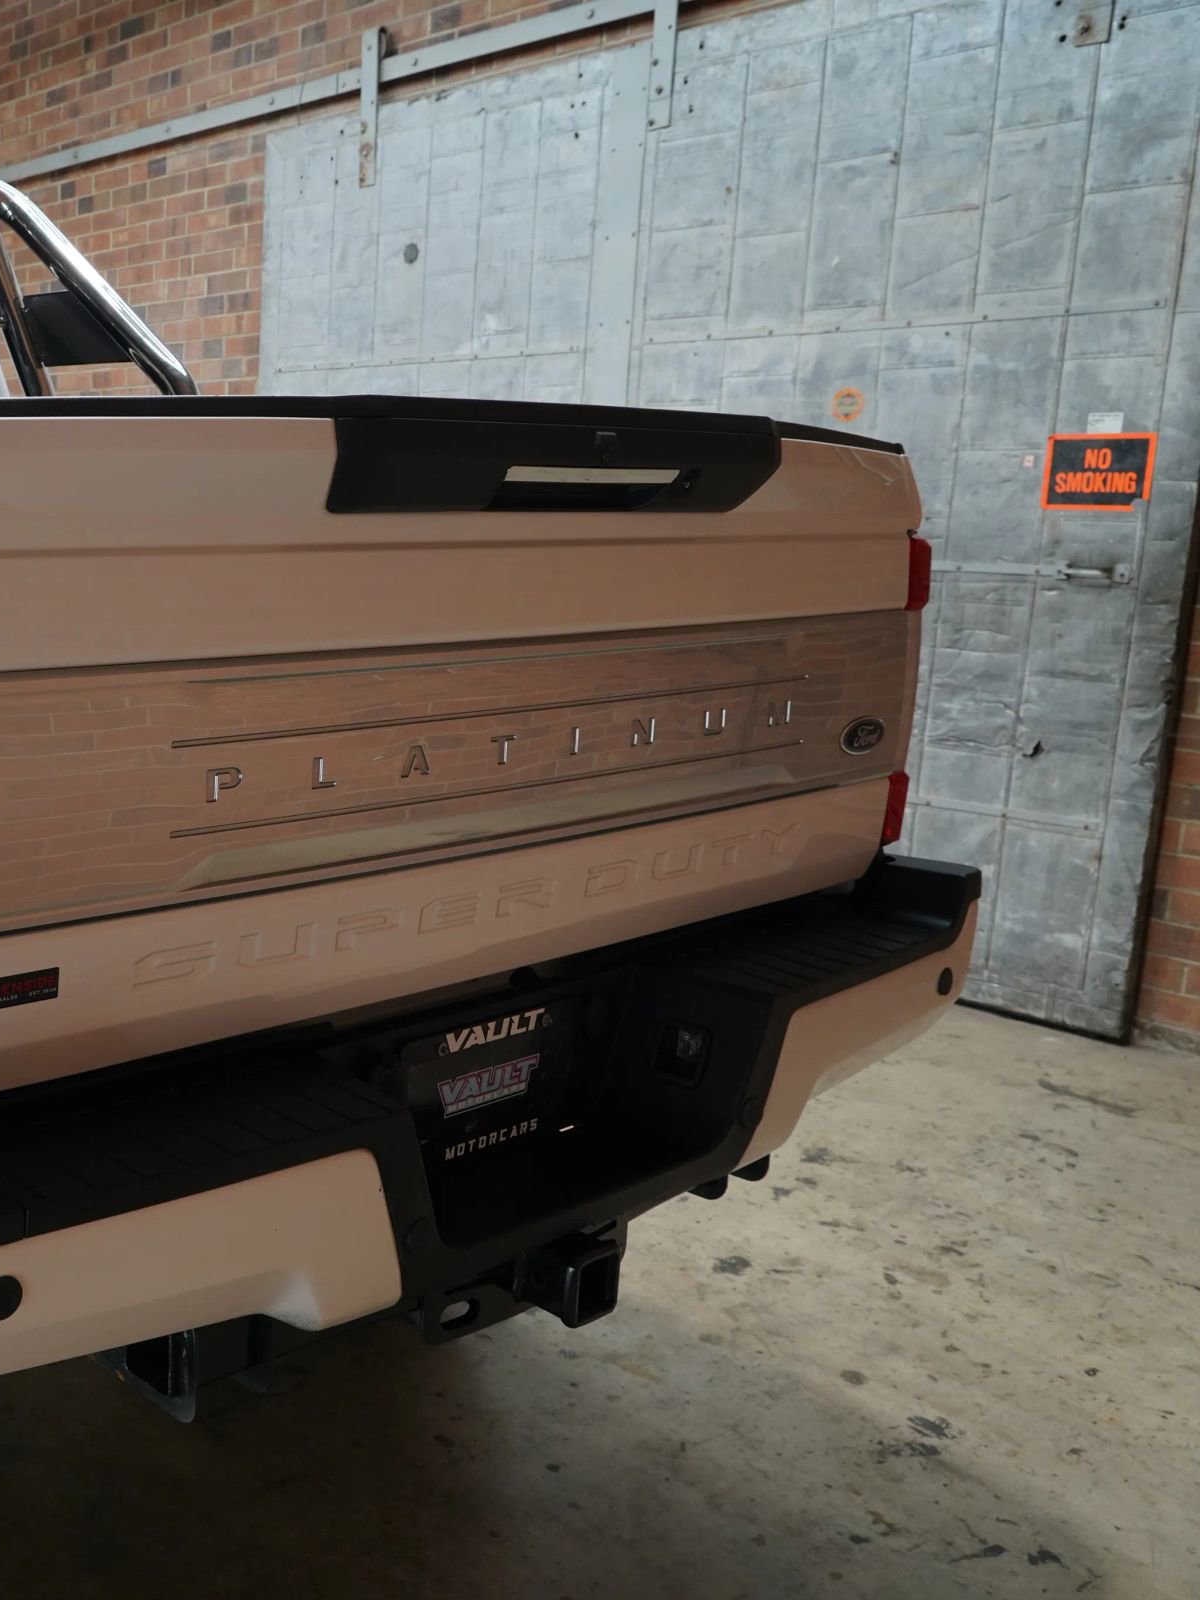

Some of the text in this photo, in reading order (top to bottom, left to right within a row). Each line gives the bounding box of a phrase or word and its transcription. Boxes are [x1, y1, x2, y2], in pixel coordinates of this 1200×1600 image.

[1084, 448, 1112, 469] NO
[1054, 471, 1137, 493] SMOKING
[205, 699, 791, 803] PLATINUM
[131, 821, 800, 988] SUPER DUTY
[0, 994, 18, 1003] SALES
[445, 1007, 545, 1053] VAULT
[439, 1057, 537, 1105] VAULT
[444, 1117, 539, 1161] MOTORCARS
